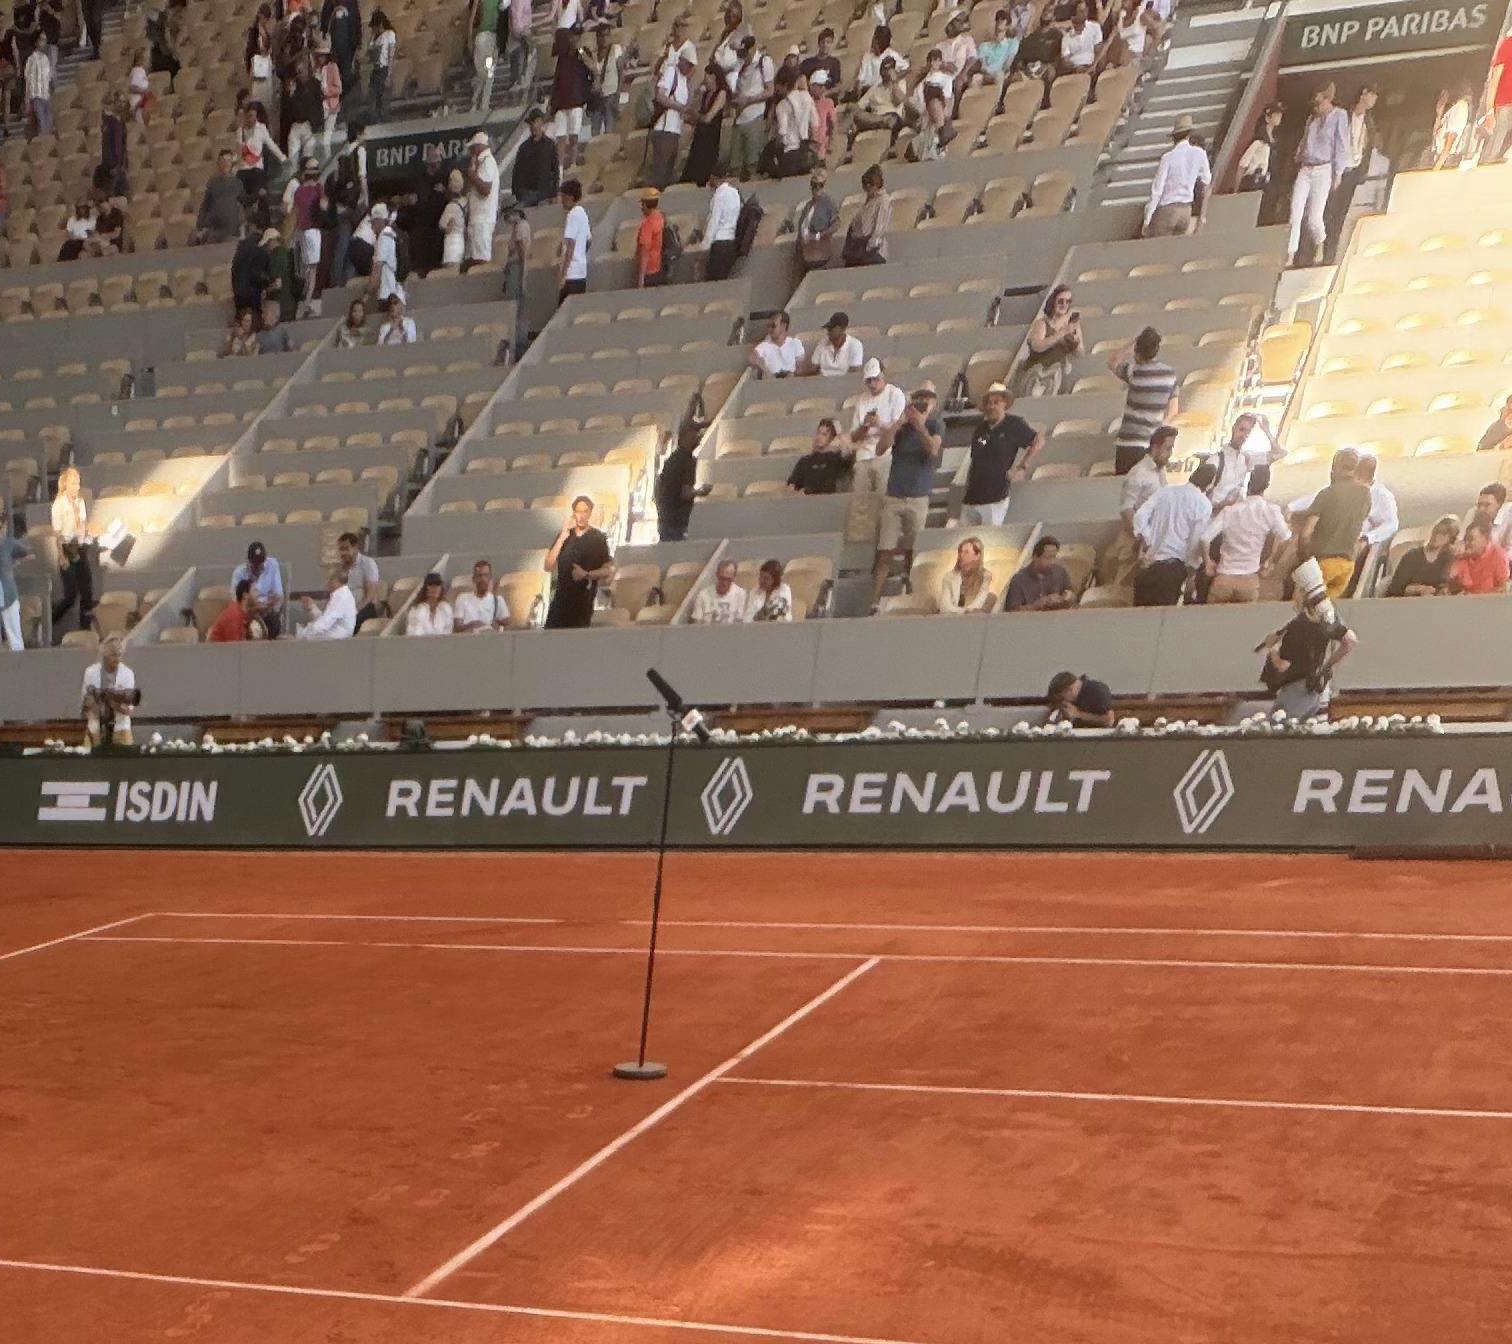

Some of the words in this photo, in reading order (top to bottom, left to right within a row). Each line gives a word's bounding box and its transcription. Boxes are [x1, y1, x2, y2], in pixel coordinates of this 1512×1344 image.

[1301, 20, 1360, 48] BNP
[1365, 4, 1488, 41] PARIBAS
[376, 144, 418, 168] BNP
[114, 780, 219, 822] ISDIN
[385, 775, 649, 817] RENAULT
[802, 770, 1111, 814] RENAULT
[1291, 768, 1512, 813] RENA
